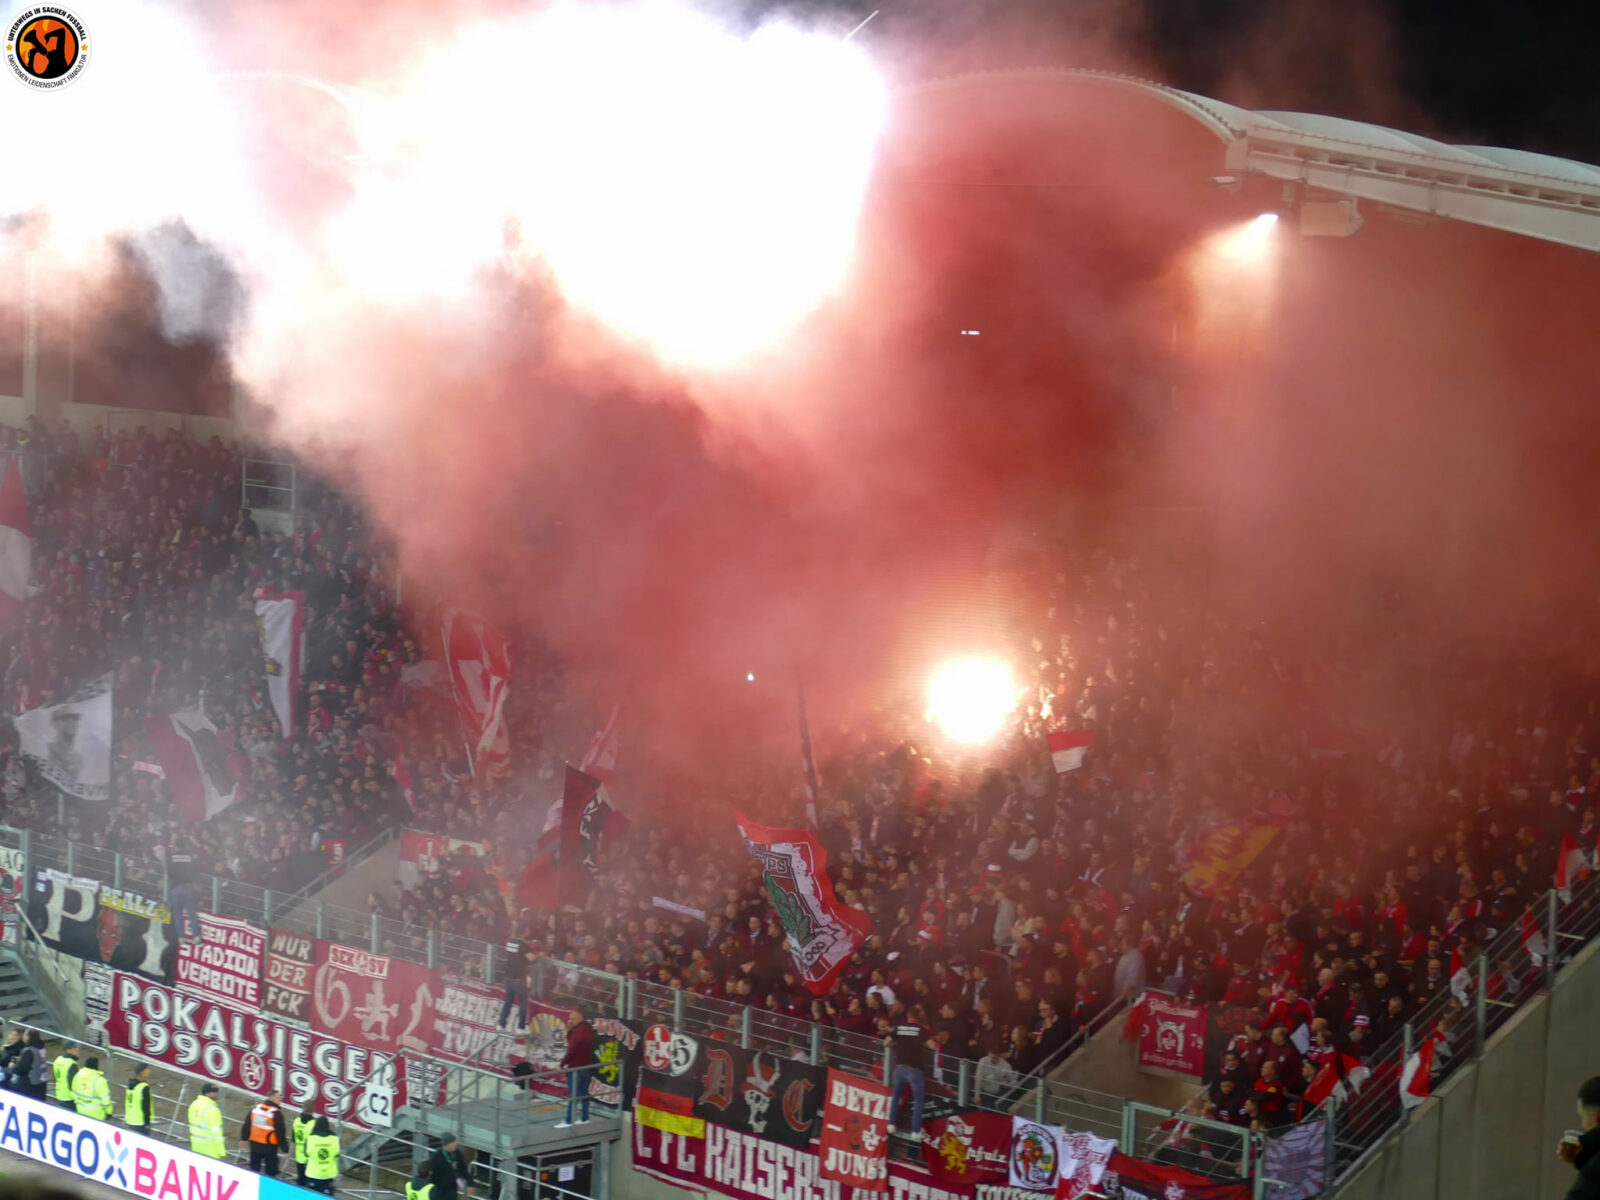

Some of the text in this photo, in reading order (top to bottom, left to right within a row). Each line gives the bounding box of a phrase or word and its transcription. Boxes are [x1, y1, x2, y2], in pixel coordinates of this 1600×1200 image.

[228, 930, 262, 955] ALLE
[271, 934, 313, 960] NUR
[177, 958, 259, 1003] VERBOTE
[268, 958, 306, 987] DER
[265, 988, 304, 1017] FCK
[119, 976, 400, 1095] POKALSIEGER
[126, 1012, 233, 1080] 1990
[269, 1058, 374, 1130] 199
[368, 1092, 391, 1117] C2
[0, 1102, 100, 1176] ARGO
[824, 1147, 889, 1180] JUNGS
